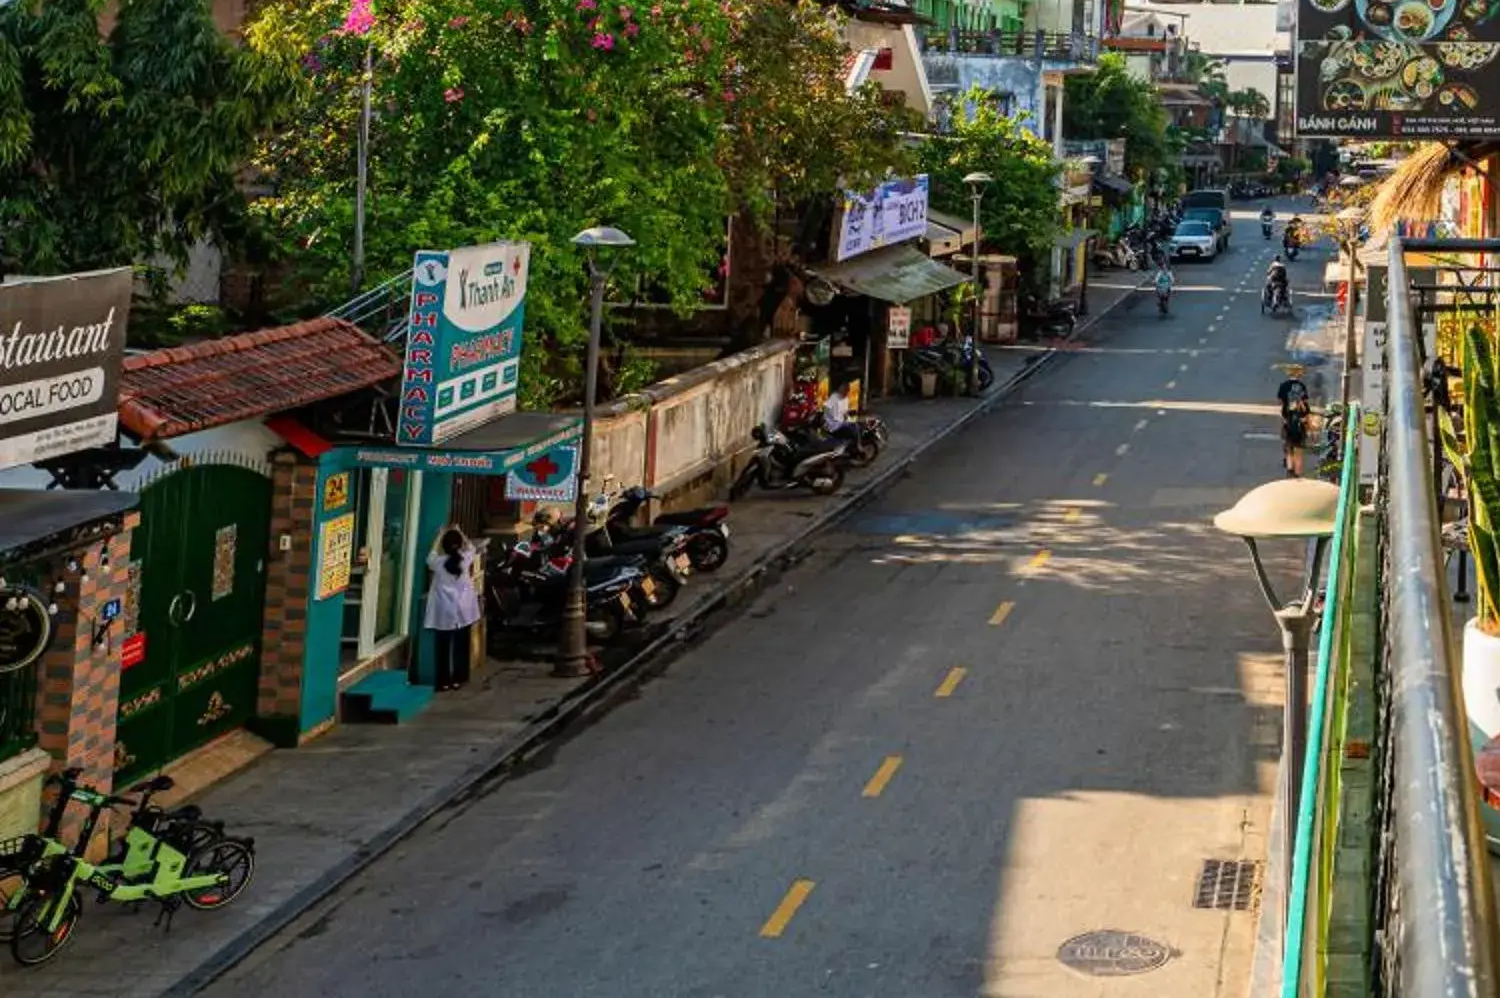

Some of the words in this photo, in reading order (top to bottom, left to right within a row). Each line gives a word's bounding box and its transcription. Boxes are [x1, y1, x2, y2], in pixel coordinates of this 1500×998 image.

[1299, 113, 1336, 131] BÁNH
[468, 276, 500, 306] Thanh
[403, 290, 438, 440] PHARMACY
[48, 377, 94, 406] FOOD
